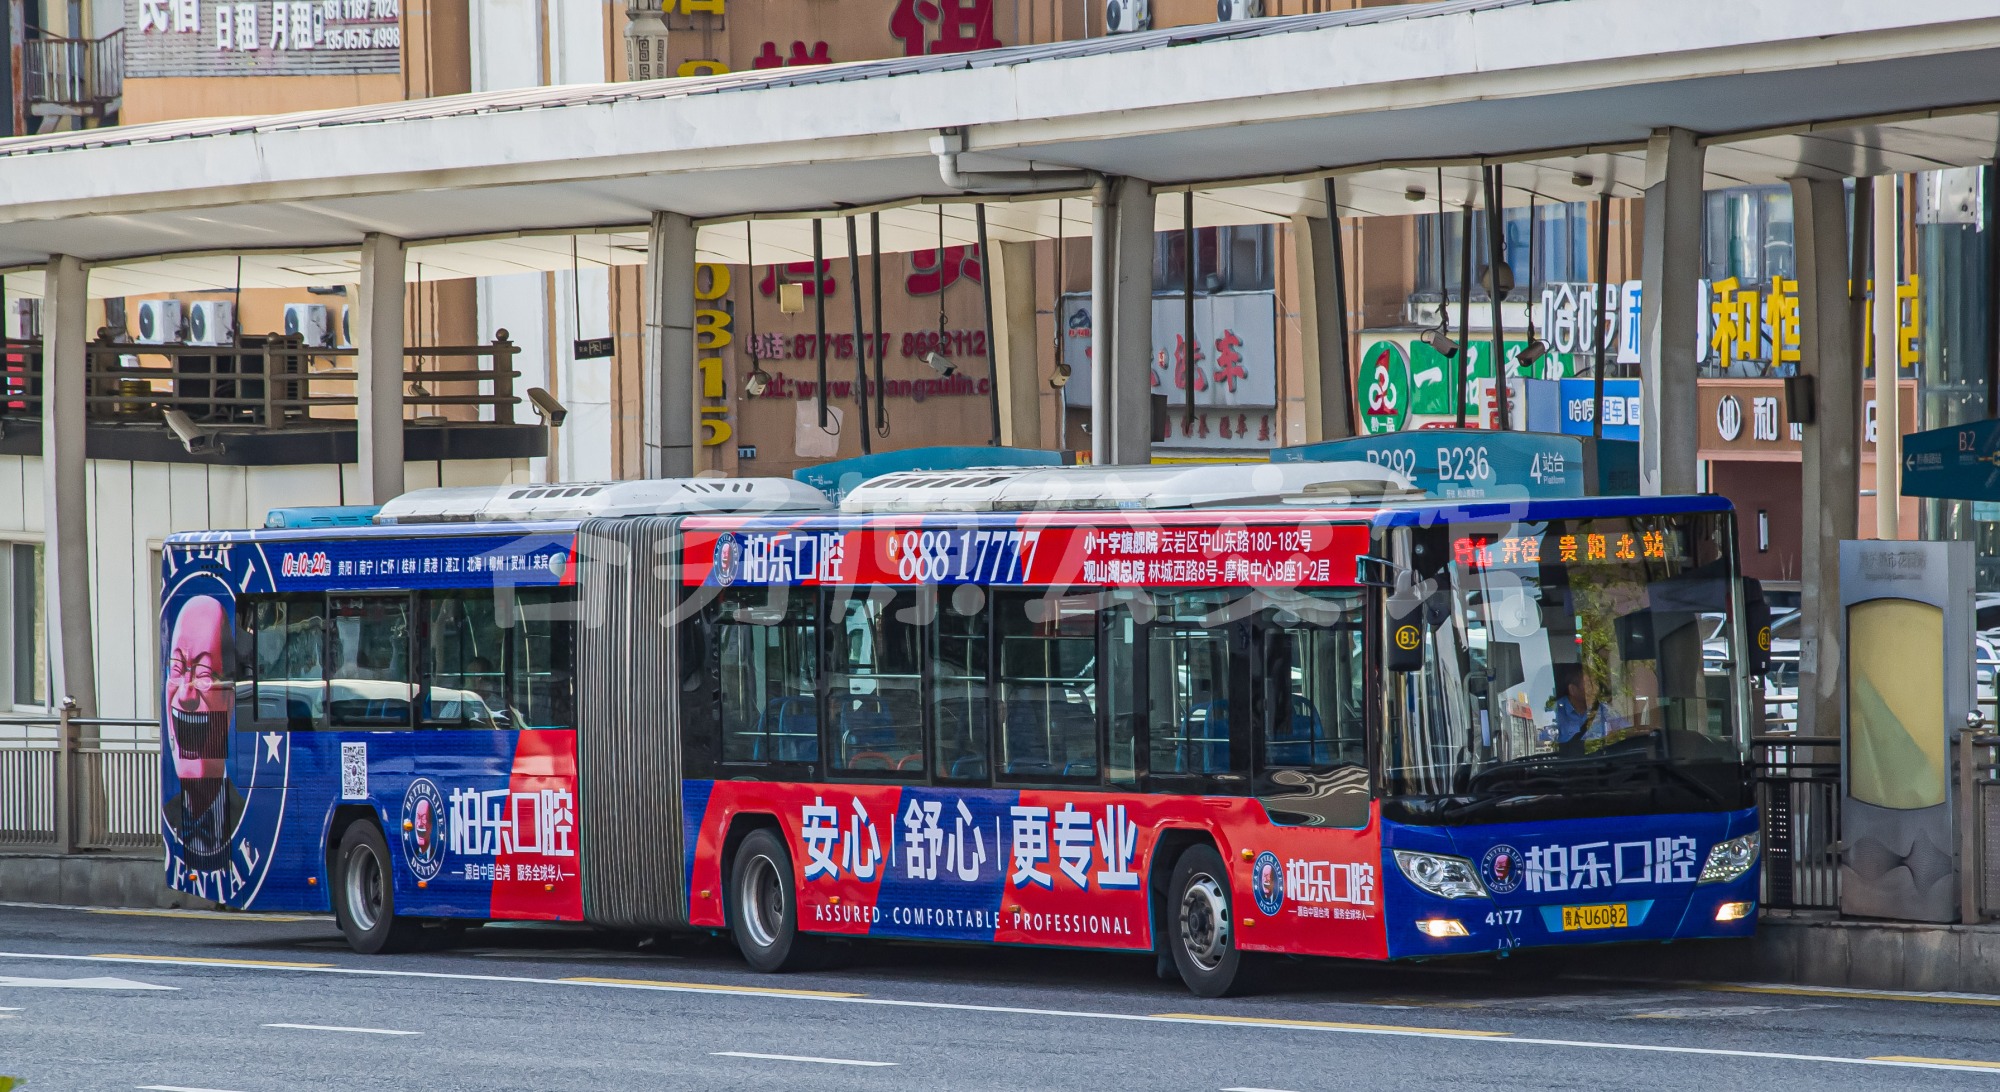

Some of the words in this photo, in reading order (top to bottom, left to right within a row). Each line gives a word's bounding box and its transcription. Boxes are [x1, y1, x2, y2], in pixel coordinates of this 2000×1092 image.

[216, 5, 259, 51] 日租
[270, 2, 314, 49] 月租
[1437, 446, 1489, 481] B236
[1530, 453, 1542, 484] 4
[1542, 452, 1565, 473] 站台
[743, 532, 844, 583] 柏乐口腔
[1083, 531, 1158, 555] 小十字旗舰院
[1161, 530, 1313, 553] 云岩区中山东路180-182号
[1502, 536, 1541, 564] 开往
[1083, 560, 1145, 584] 观山湖总院
[1400, 631, 1417, 645] B1
[449, 788, 574, 857] 柏乐口腔
[801, 796, 881, 881] 安心
[903, 798, 985, 882] 舒心
[1010, 801, 1139, 889] 更专业
[163, 836, 260, 904] ENTAL
[411, 856, 440, 876] DENTAL
[1525, 836, 1697, 893] 柏乐口腔
[1286, 858, 1375, 906] 柏乐口腔
[815, 904, 880, 923] ASSURED
[894, 908, 1000, 929] COMFORTABLE
[1013, 912, 1132, 936] PROFESSIONAL
[1485, 909, 1522, 926] 4177
